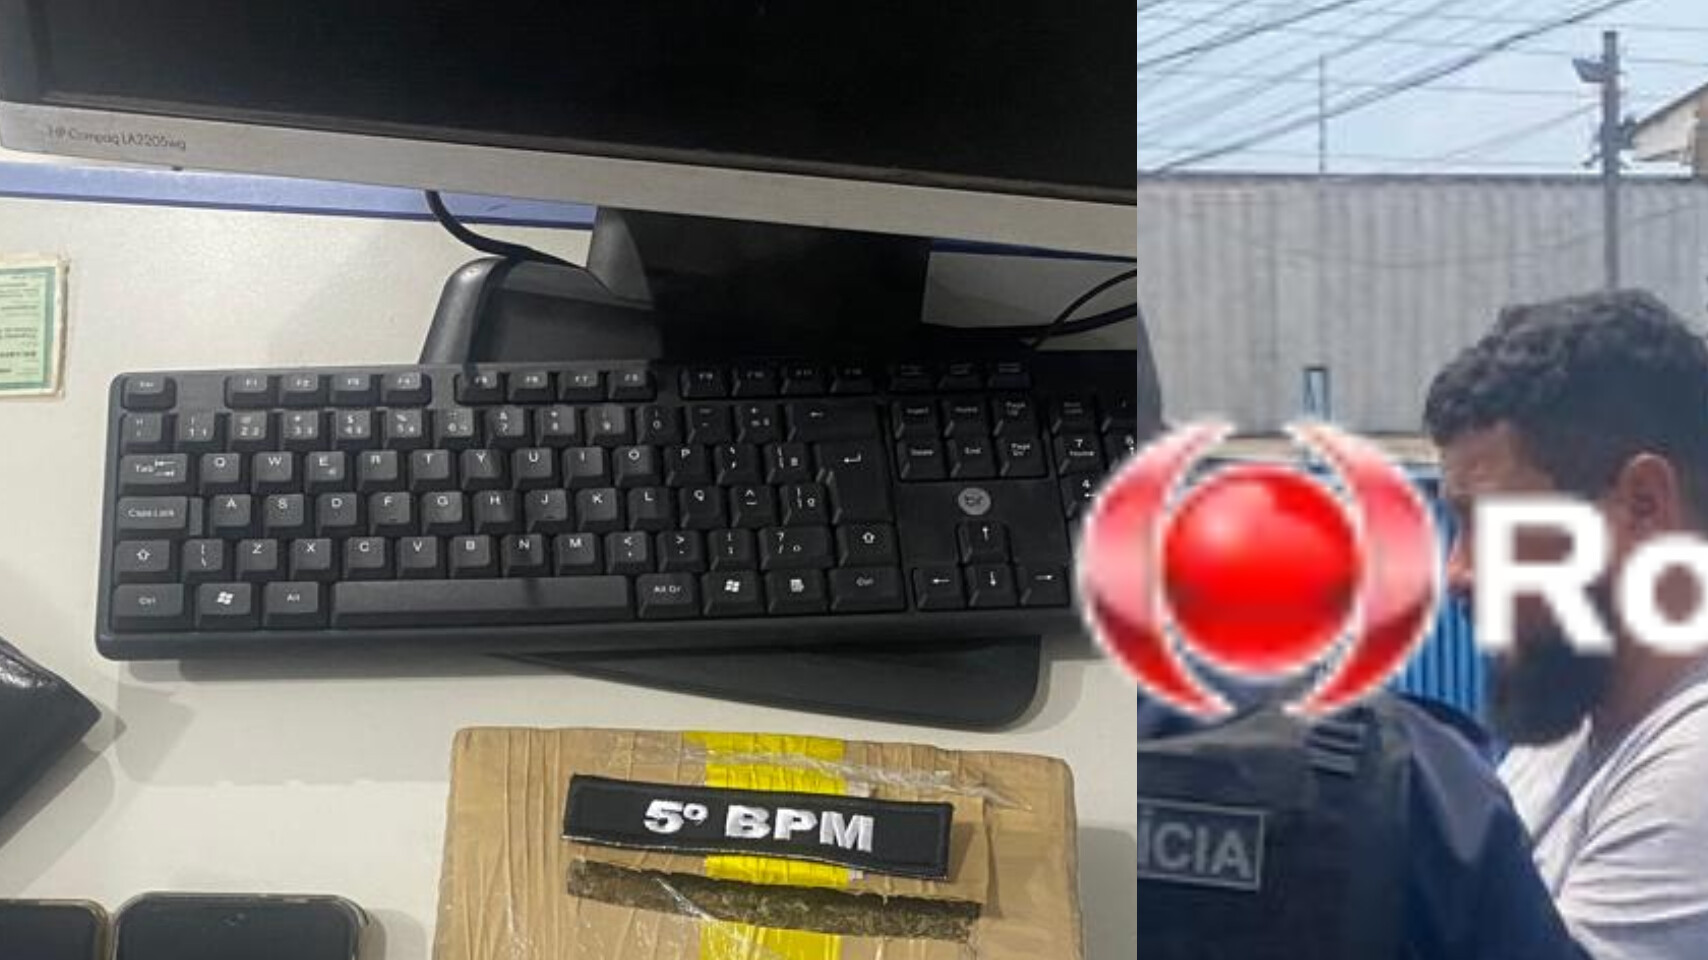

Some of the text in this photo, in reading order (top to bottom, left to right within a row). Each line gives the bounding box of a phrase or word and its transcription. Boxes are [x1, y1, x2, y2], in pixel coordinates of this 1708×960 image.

[423, 452, 435, 464] T
[476, 452, 487, 463] Y
[528, 451, 540, 463] U
[628, 449, 641, 461] O
[681, 448, 692, 459] P
[213, 457, 227, 468] Q
[268, 456, 283, 467] W
[318, 456, 329, 468] E
[384, 496, 393, 506] F
[437, 496, 448, 507] G
[489, 495, 501, 506] H
[540, 493, 549, 505] J
[644, 490, 654, 502] L
[226, 497, 237, 509] A
[277, 498, 288, 509] S
[331, 498, 343, 508] D
[252, 543, 263, 554] Z
[306, 543, 316, 553] X
[359, 541, 370, 552] C
[412, 541, 423, 552] V
[518, 538, 531, 550] N
[569, 538, 582, 549] M
[725, 805, 874, 854] BPM
